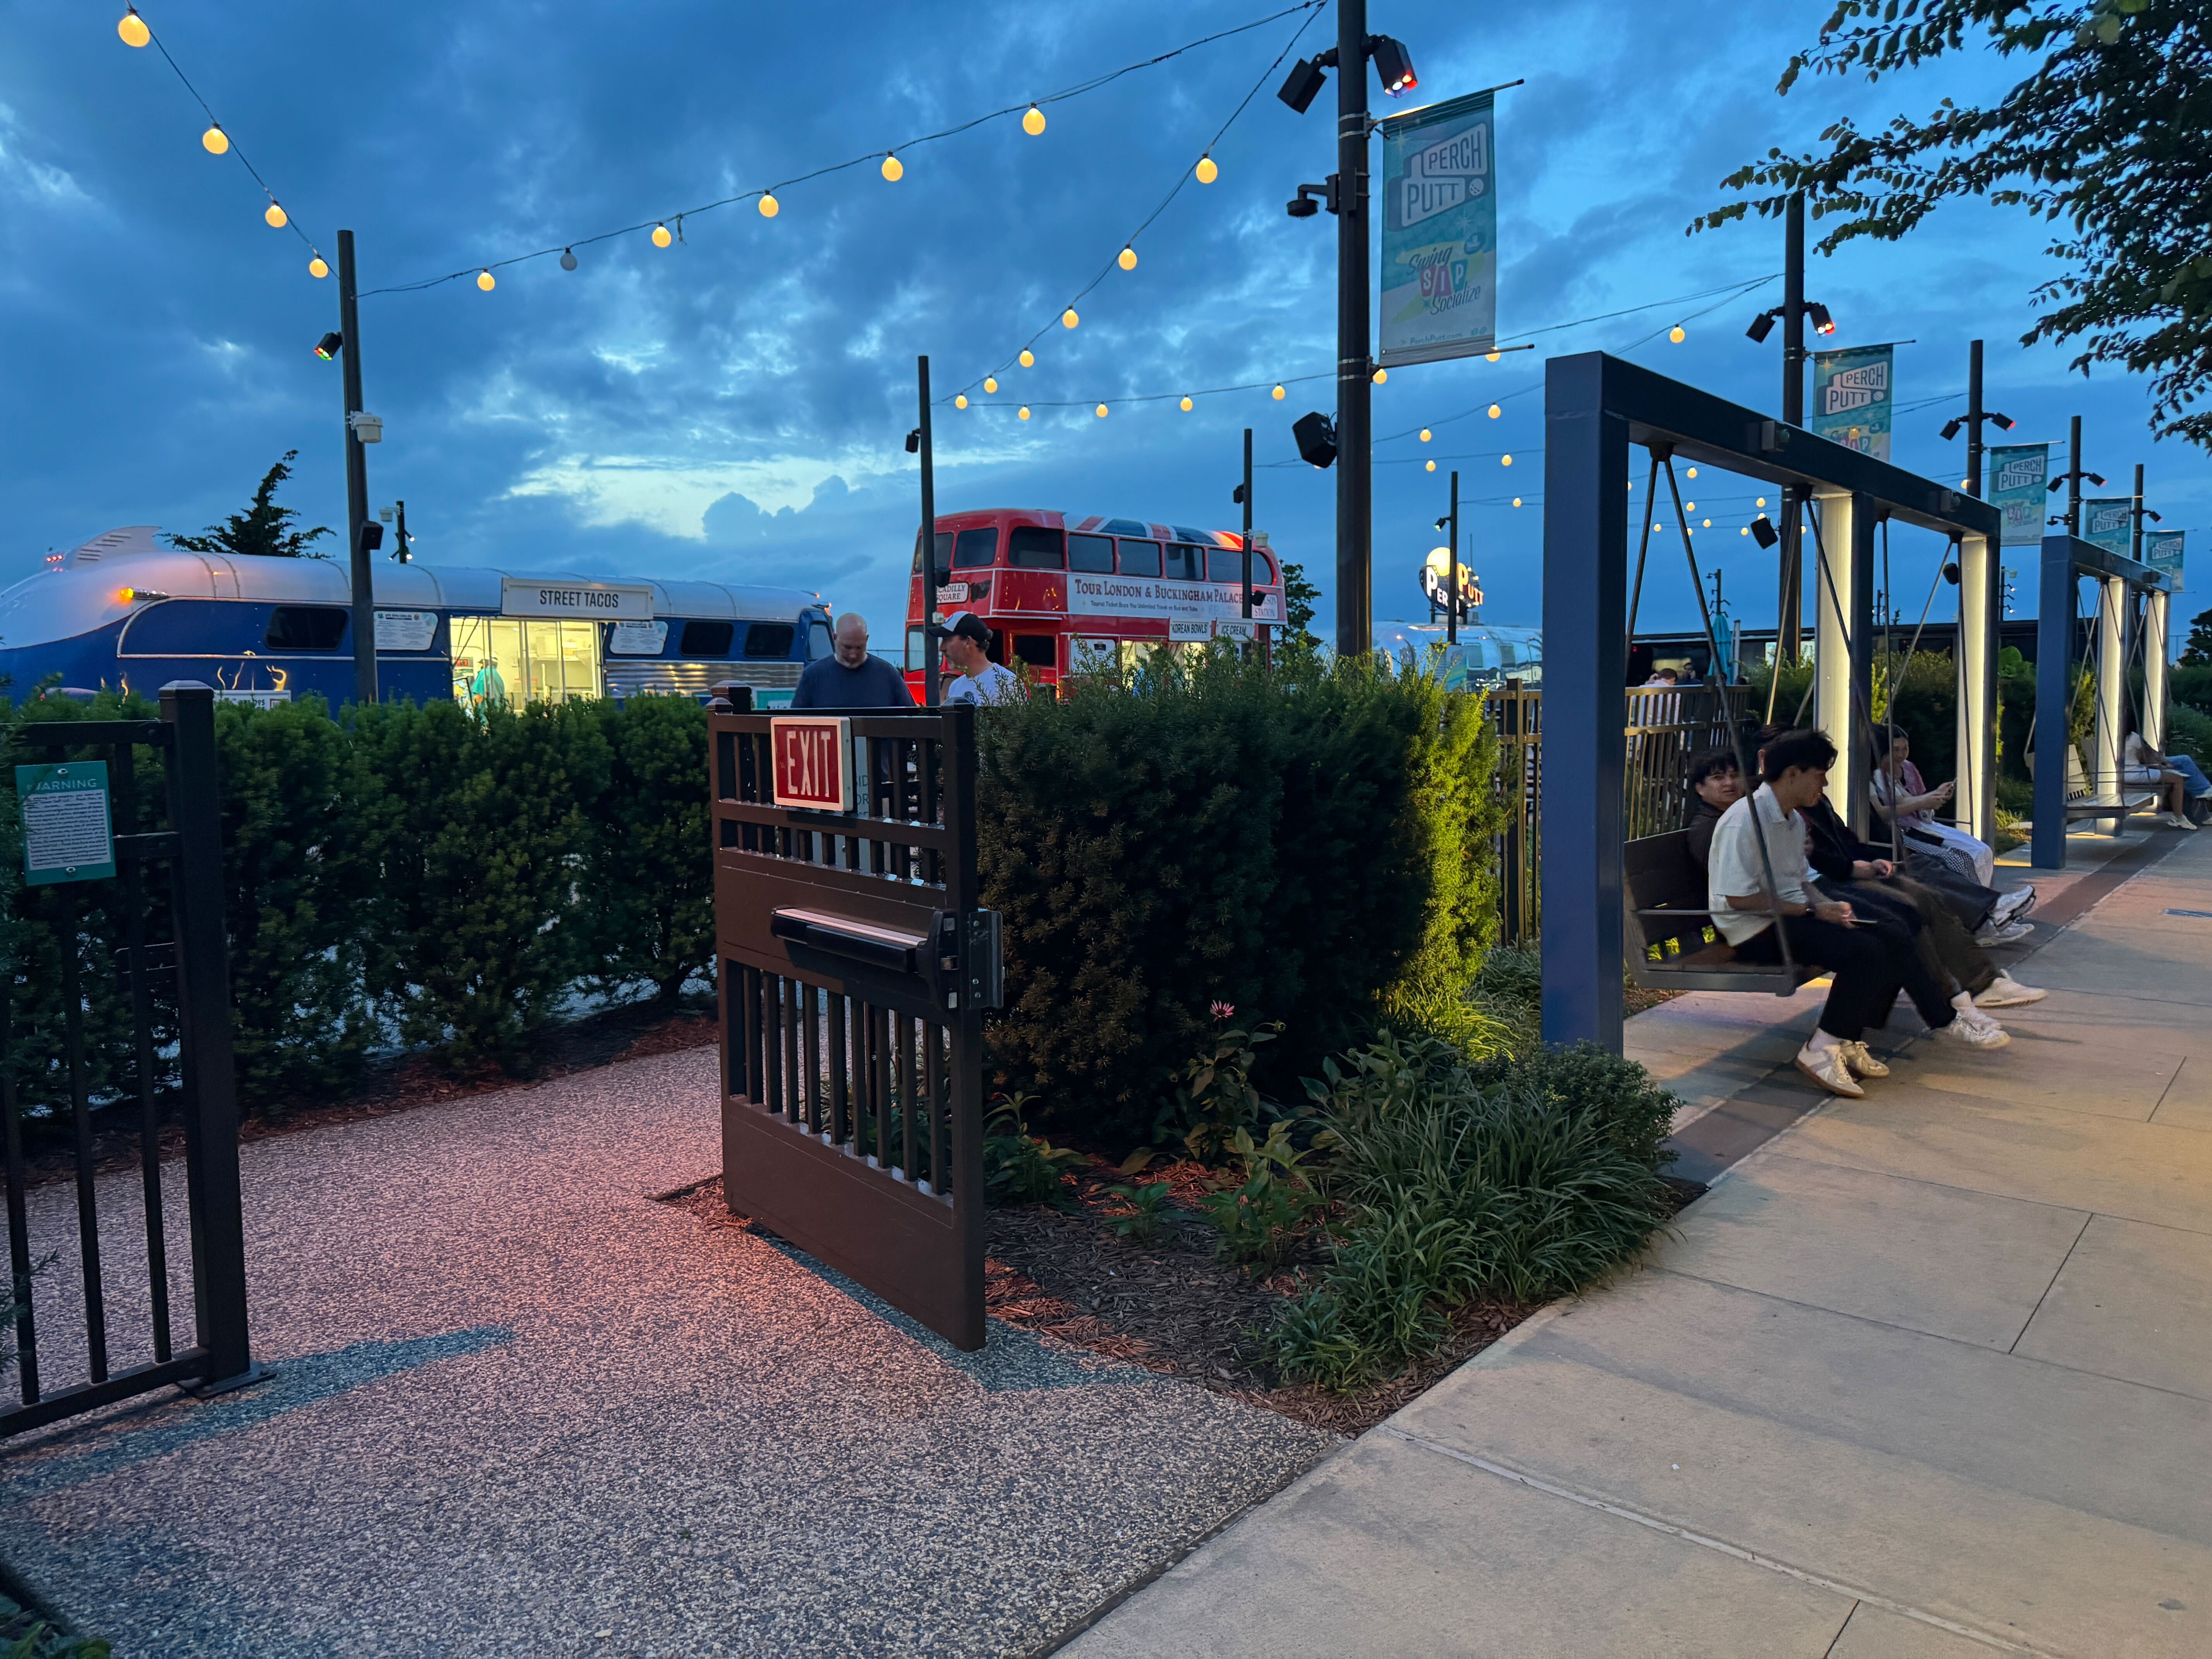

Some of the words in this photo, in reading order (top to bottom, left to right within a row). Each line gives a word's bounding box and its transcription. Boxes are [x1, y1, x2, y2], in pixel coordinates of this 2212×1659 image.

[1429, 131, 1481, 170] PERCH
[1407, 183, 1459, 220] PUTT
[1406, 246, 1453, 276] Swing
[1423, 264, 1464, 291] SIP
[1430, 281, 1480, 315] Socialize
[1846, 365, 1883, 386] PERCH
[1830, 390, 1867, 410] PUTT
[2013, 458, 2042, 473] PERCH
[2001, 474, 2028, 488] PUTT
[2094, 520, 2116, 531] PUTT
[1075, 579, 1102, 595] TOUR
[1104, 581, 1142, 597] LONDON
[1145, 586, 1151, 598] &
[1155, 584, 1213, 602] BUCKINGHAM
[1457, 563, 1484, 605] PUTT
[540, 590, 582, 606] STREET
[584, 592, 619, 608] TACOS
[1172, 623, 1190, 634] KOREAN
[1191, 624, 1207, 634] BOWLS
[1221, 625, 1229, 634] ICE
[1230, 626, 1246, 635] CREAM
[787, 730, 831, 797] EXIT
